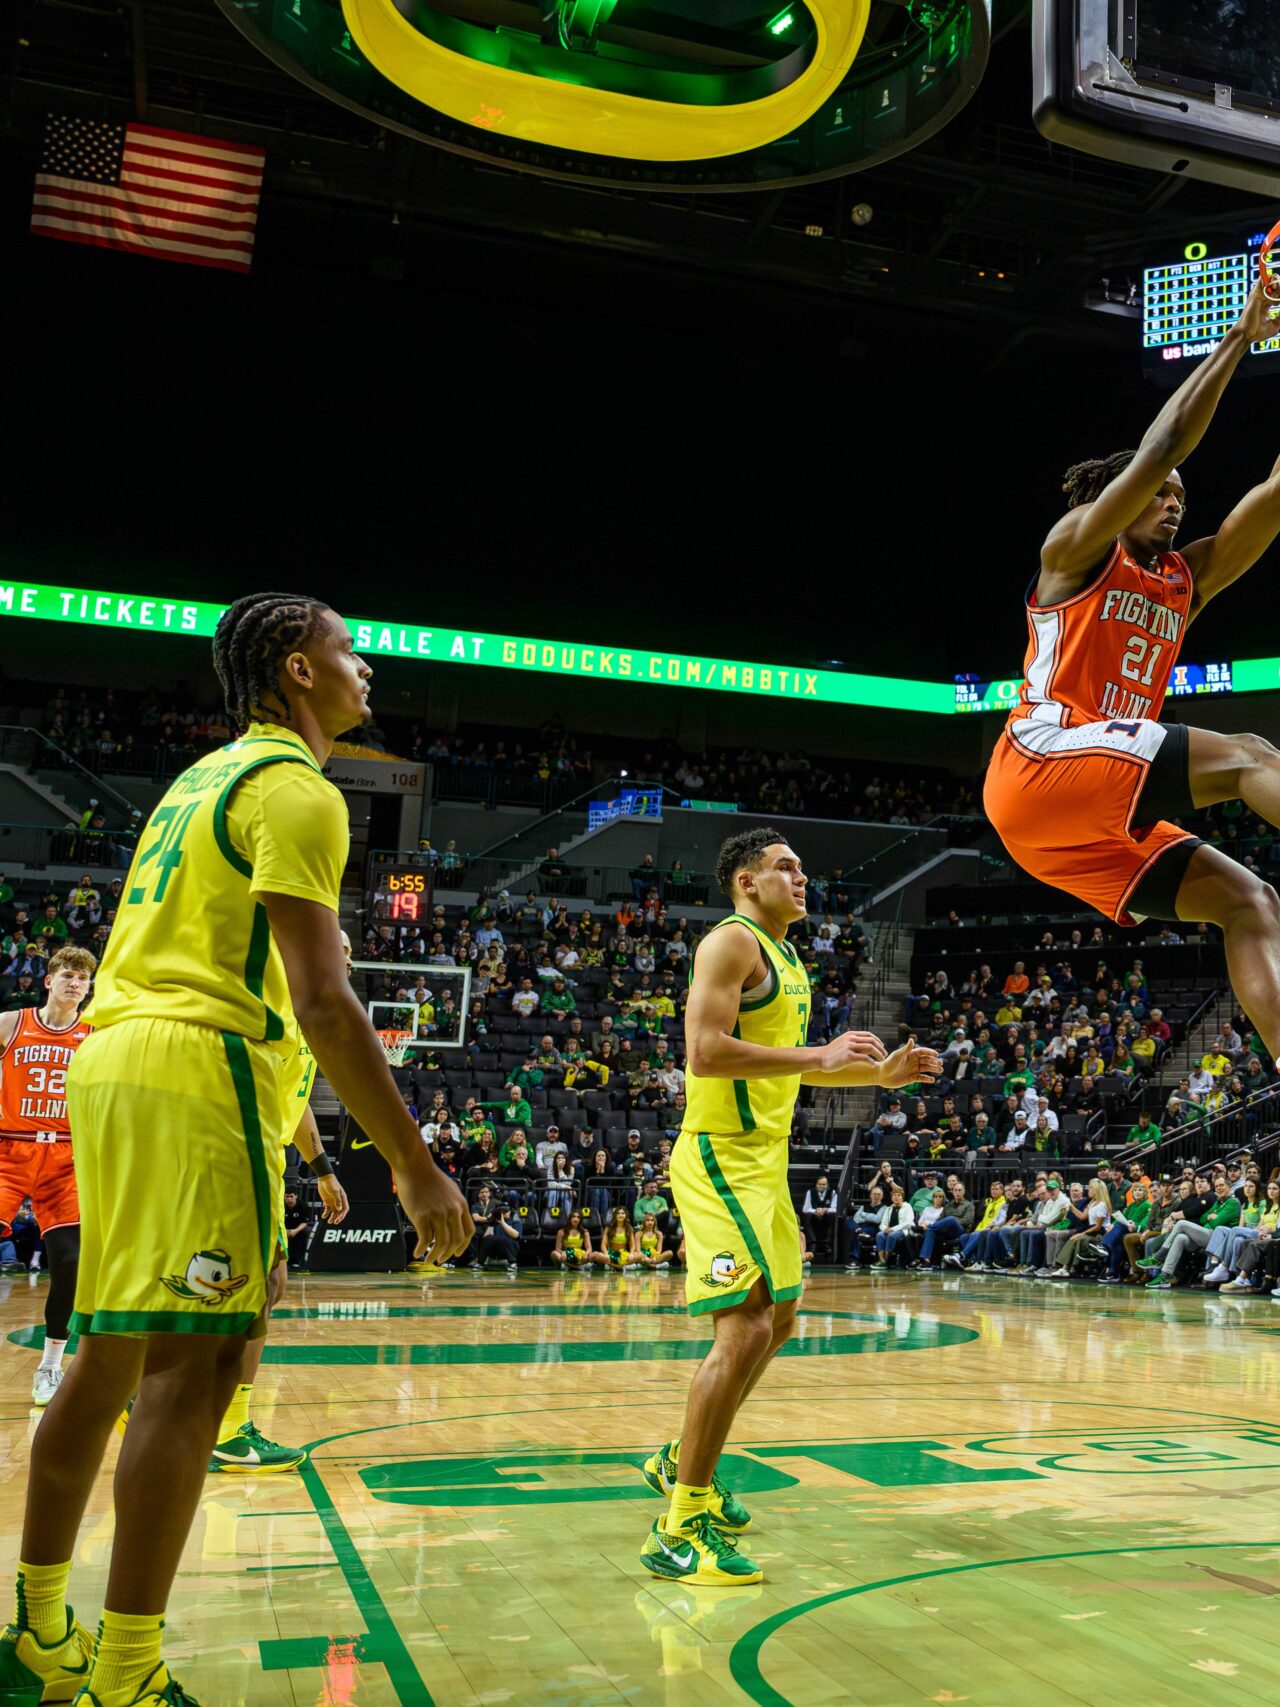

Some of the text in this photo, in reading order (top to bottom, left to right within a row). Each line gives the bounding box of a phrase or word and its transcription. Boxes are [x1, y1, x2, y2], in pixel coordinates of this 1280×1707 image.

[1163, 347, 1181, 360] us
[60, 592, 198, 630] TICKETS
[356, 625, 433, 655] SALE
[450, 635, 485, 660] AT
[502, 640, 820, 696] GODUCKS.COM/MBBTIX
[1120, 634, 1163, 686] 21
[127, 800, 202, 904] 24
[389, 874, 425, 892] 6:55
[392, 893, 418, 920] 19
[27, 1068, 67, 1094] 32
